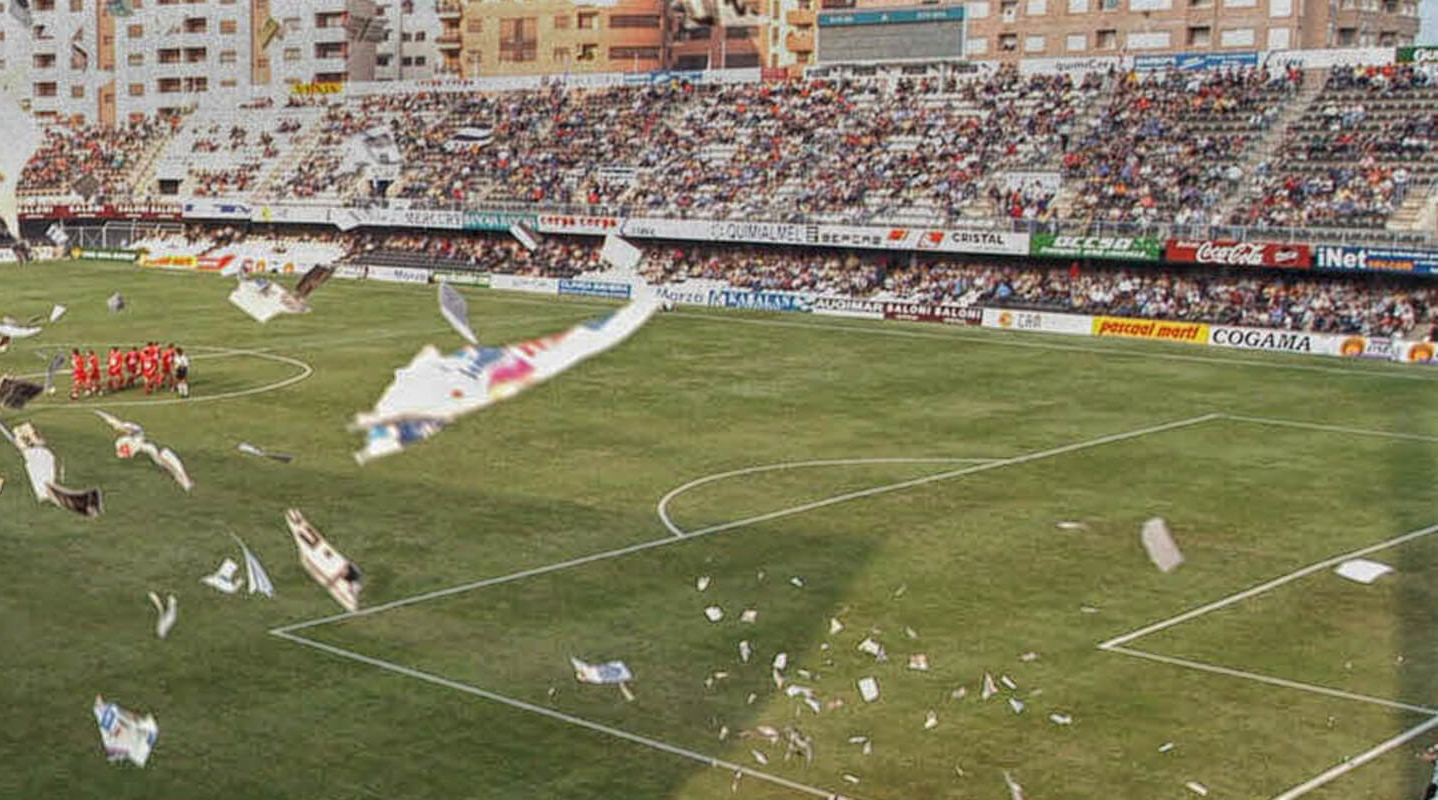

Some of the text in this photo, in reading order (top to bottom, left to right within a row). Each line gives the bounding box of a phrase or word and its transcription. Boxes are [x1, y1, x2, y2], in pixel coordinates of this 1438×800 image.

[952, 232, 1005, 245] CRISTAL
[1318, 247, 1366, 269] iNet
[1212, 329, 1312, 351] COGAMA
